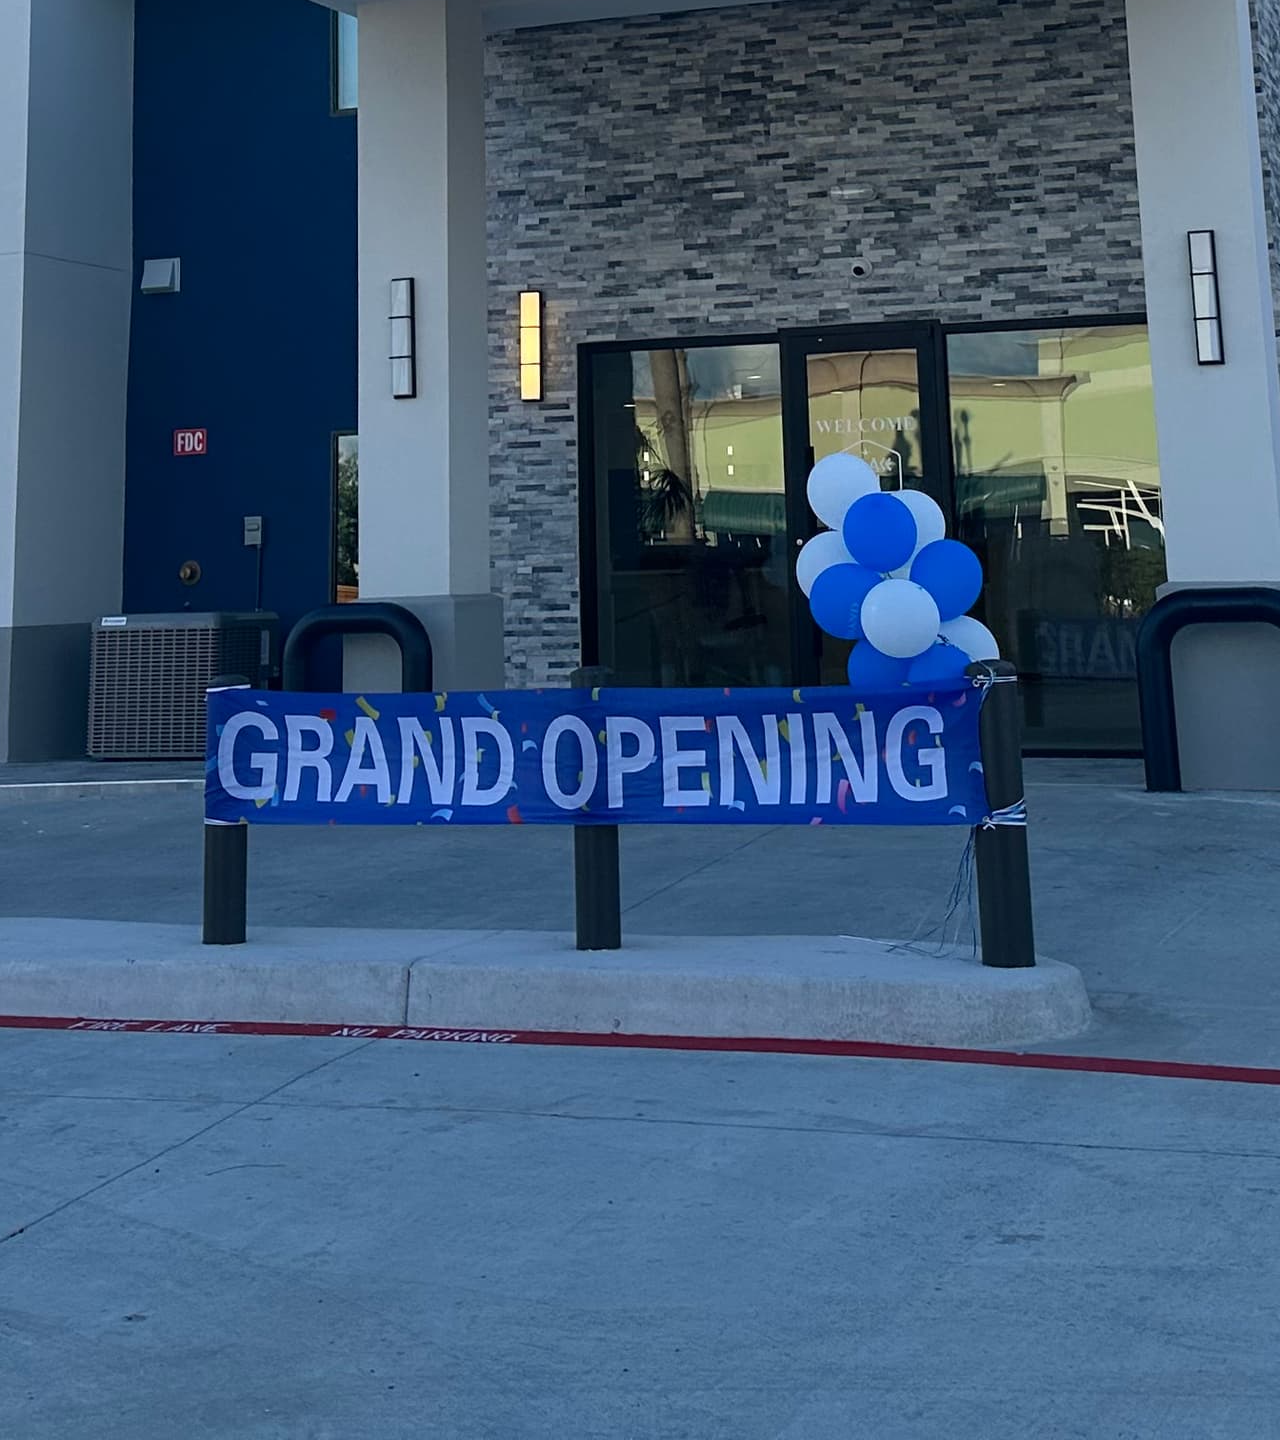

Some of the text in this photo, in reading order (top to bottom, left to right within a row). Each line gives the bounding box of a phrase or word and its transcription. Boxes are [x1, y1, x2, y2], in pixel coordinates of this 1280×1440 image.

[816, 416, 918, 433] WELCOME
[177, 431, 203, 452] FDC
[217, 705, 949, 811] GRAND OPENING
[145, 1022, 231, 1033] LANE
[331, 1027, 517, 1042] NO PARKING
